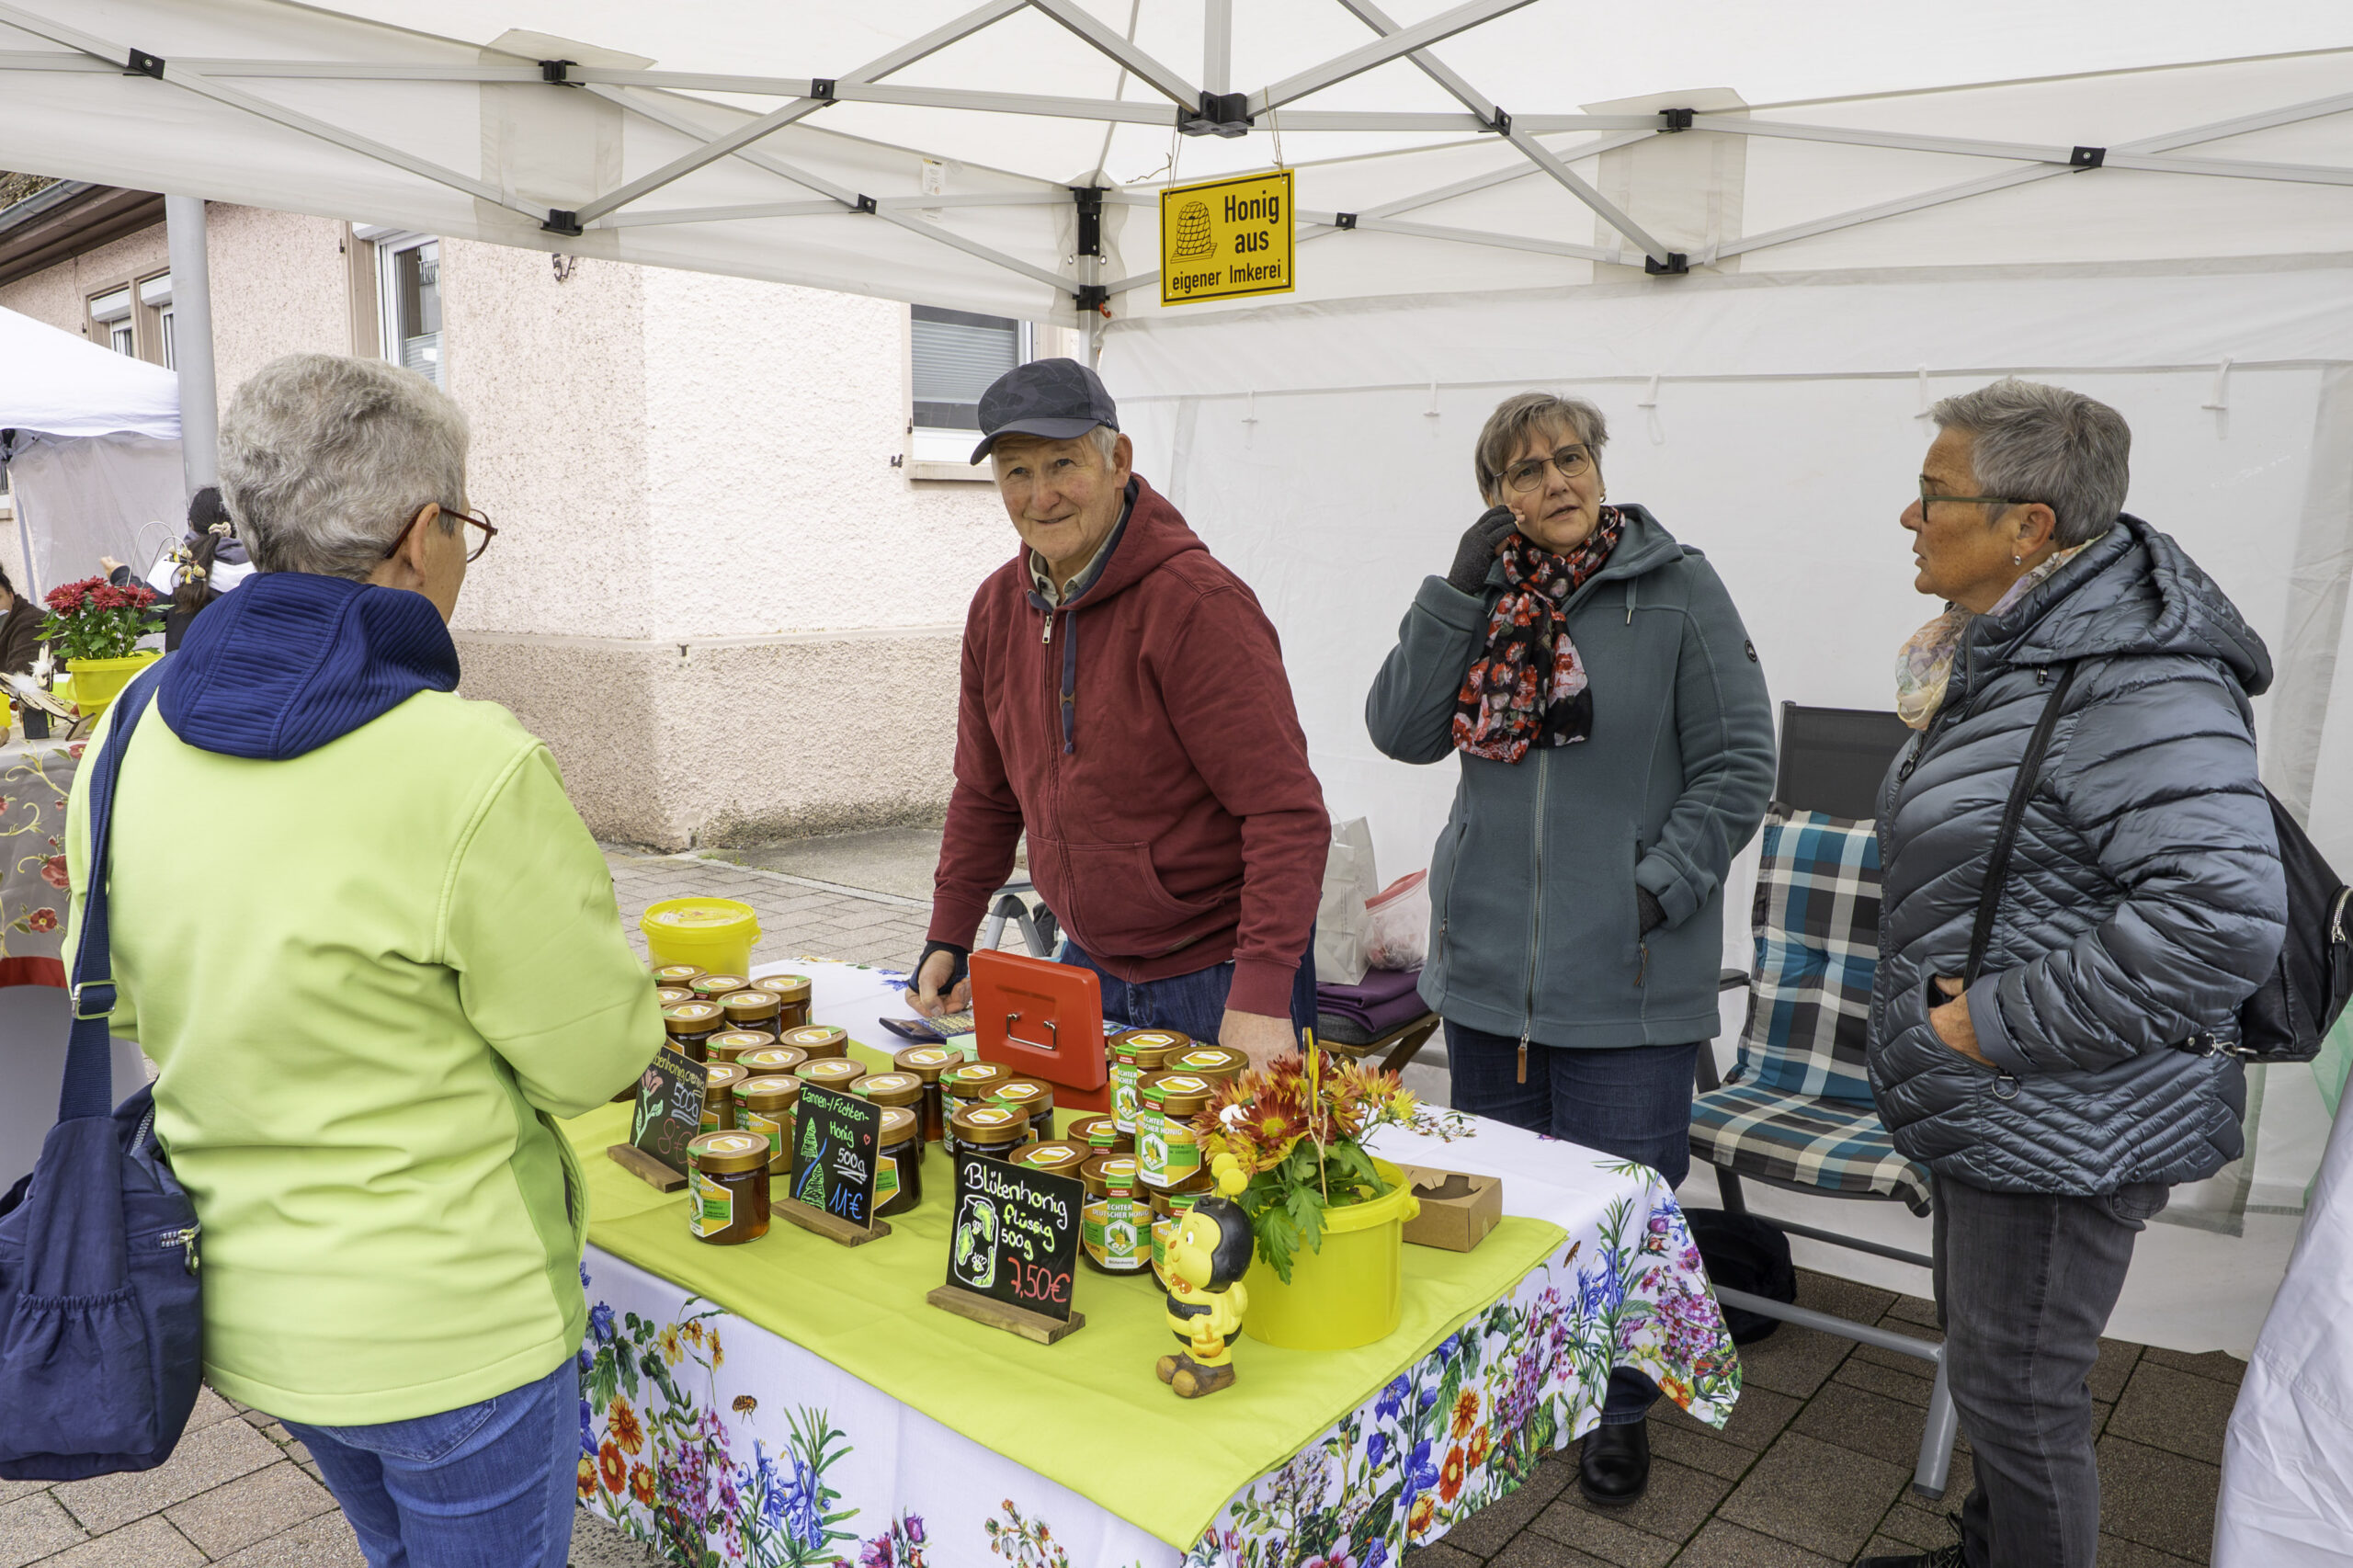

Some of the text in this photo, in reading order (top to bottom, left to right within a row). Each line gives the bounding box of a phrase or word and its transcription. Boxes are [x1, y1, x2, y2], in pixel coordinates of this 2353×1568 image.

[1224, 189, 1279, 224] Honig
[1234, 231, 1269, 254] aus
[1172, 259, 1281, 294] eigener Imkerei
[671, 1082, 699, 1126] 500g
[829, 1120, 855, 1149] Honig
[1160, 1125, 1183, 1136] HONIG
[837, 1147, 868, 1179] 500g
[699, 1184, 715, 1193] HONIG
[964, 1162, 1068, 1231] Blütenhonig
[1003, 1203, 1055, 1253] flüssig
[1092, 1208, 1149, 1219] DEUTSCHER HONIG
[1001, 1228, 1034, 1261] 500g
[1007, 1256, 1070, 1303] 7,50€
